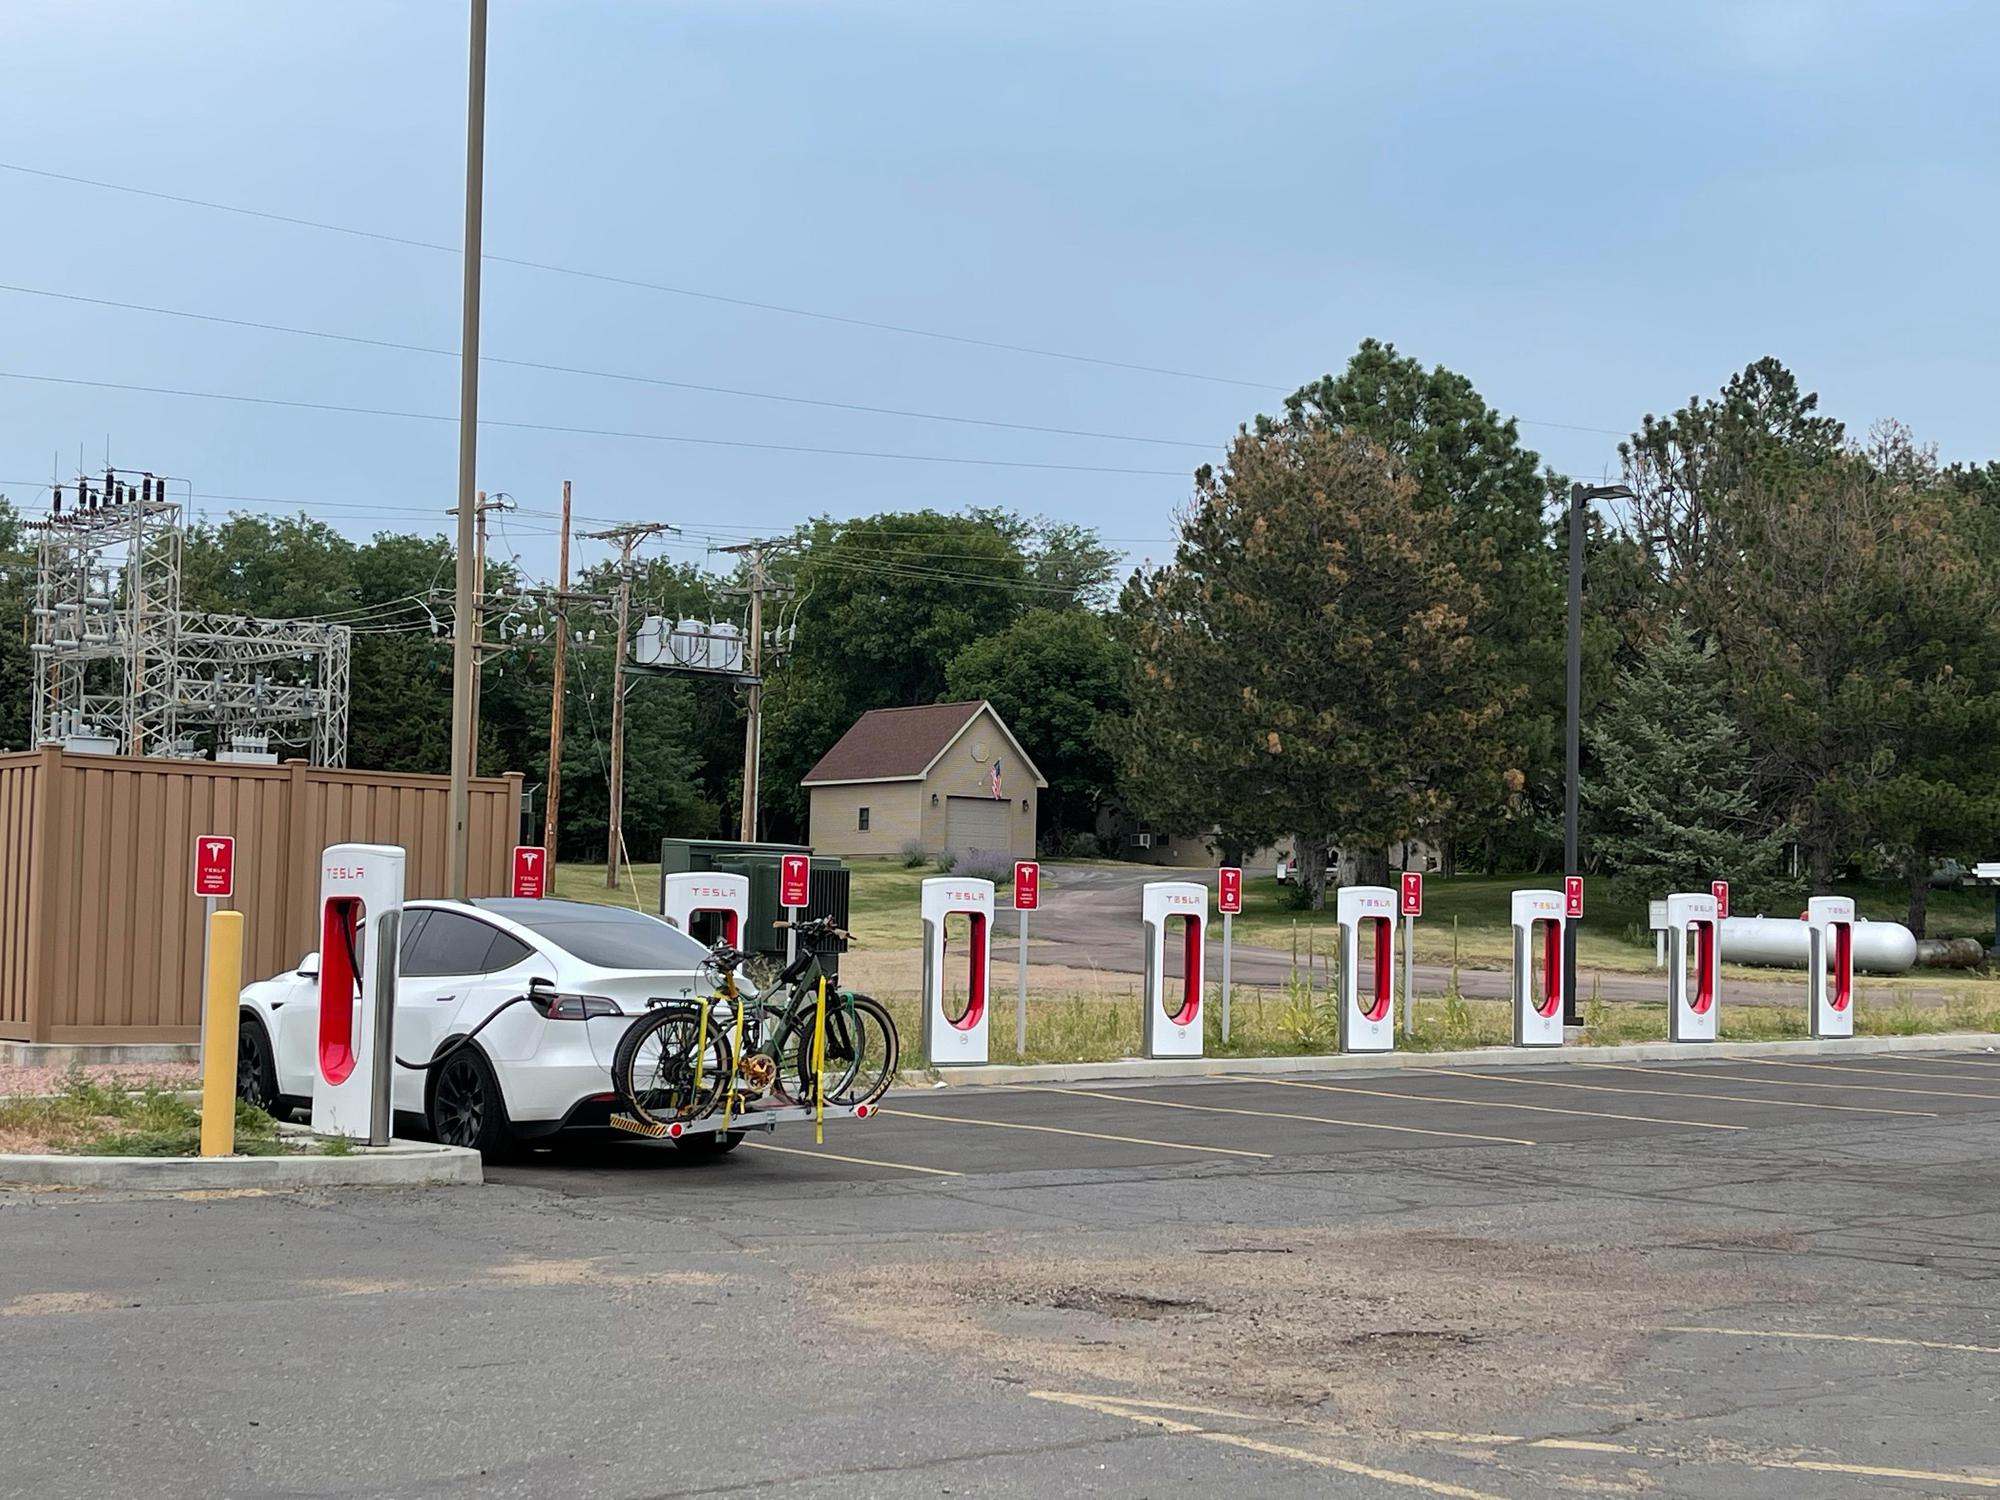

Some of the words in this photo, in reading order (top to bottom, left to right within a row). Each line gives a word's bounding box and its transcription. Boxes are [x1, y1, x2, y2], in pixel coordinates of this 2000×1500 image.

[326, 867, 364, 879] TESLA
[692, 887, 736, 897] TESLA
[945, 892, 985, 900] TESLA
[1166, 895, 1200, 904] TESLA
[1359, 899, 1391, 907] TESLA
